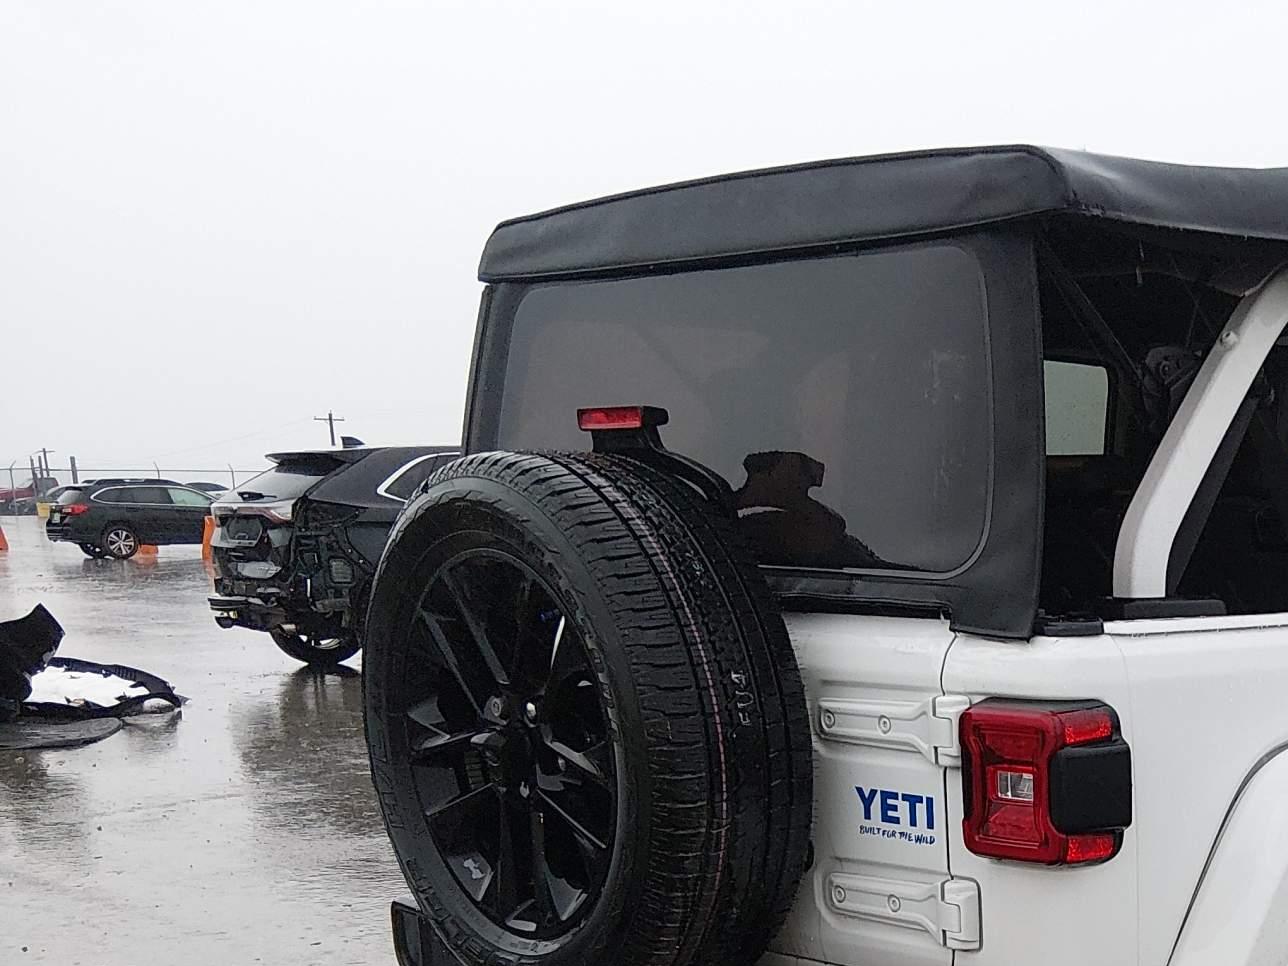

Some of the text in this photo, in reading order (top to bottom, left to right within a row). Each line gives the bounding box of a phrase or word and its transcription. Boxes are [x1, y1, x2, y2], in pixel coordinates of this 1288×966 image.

[855, 786, 935, 830] YETI
[859, 825, 936, 845] BUILT FOR THE WILD
